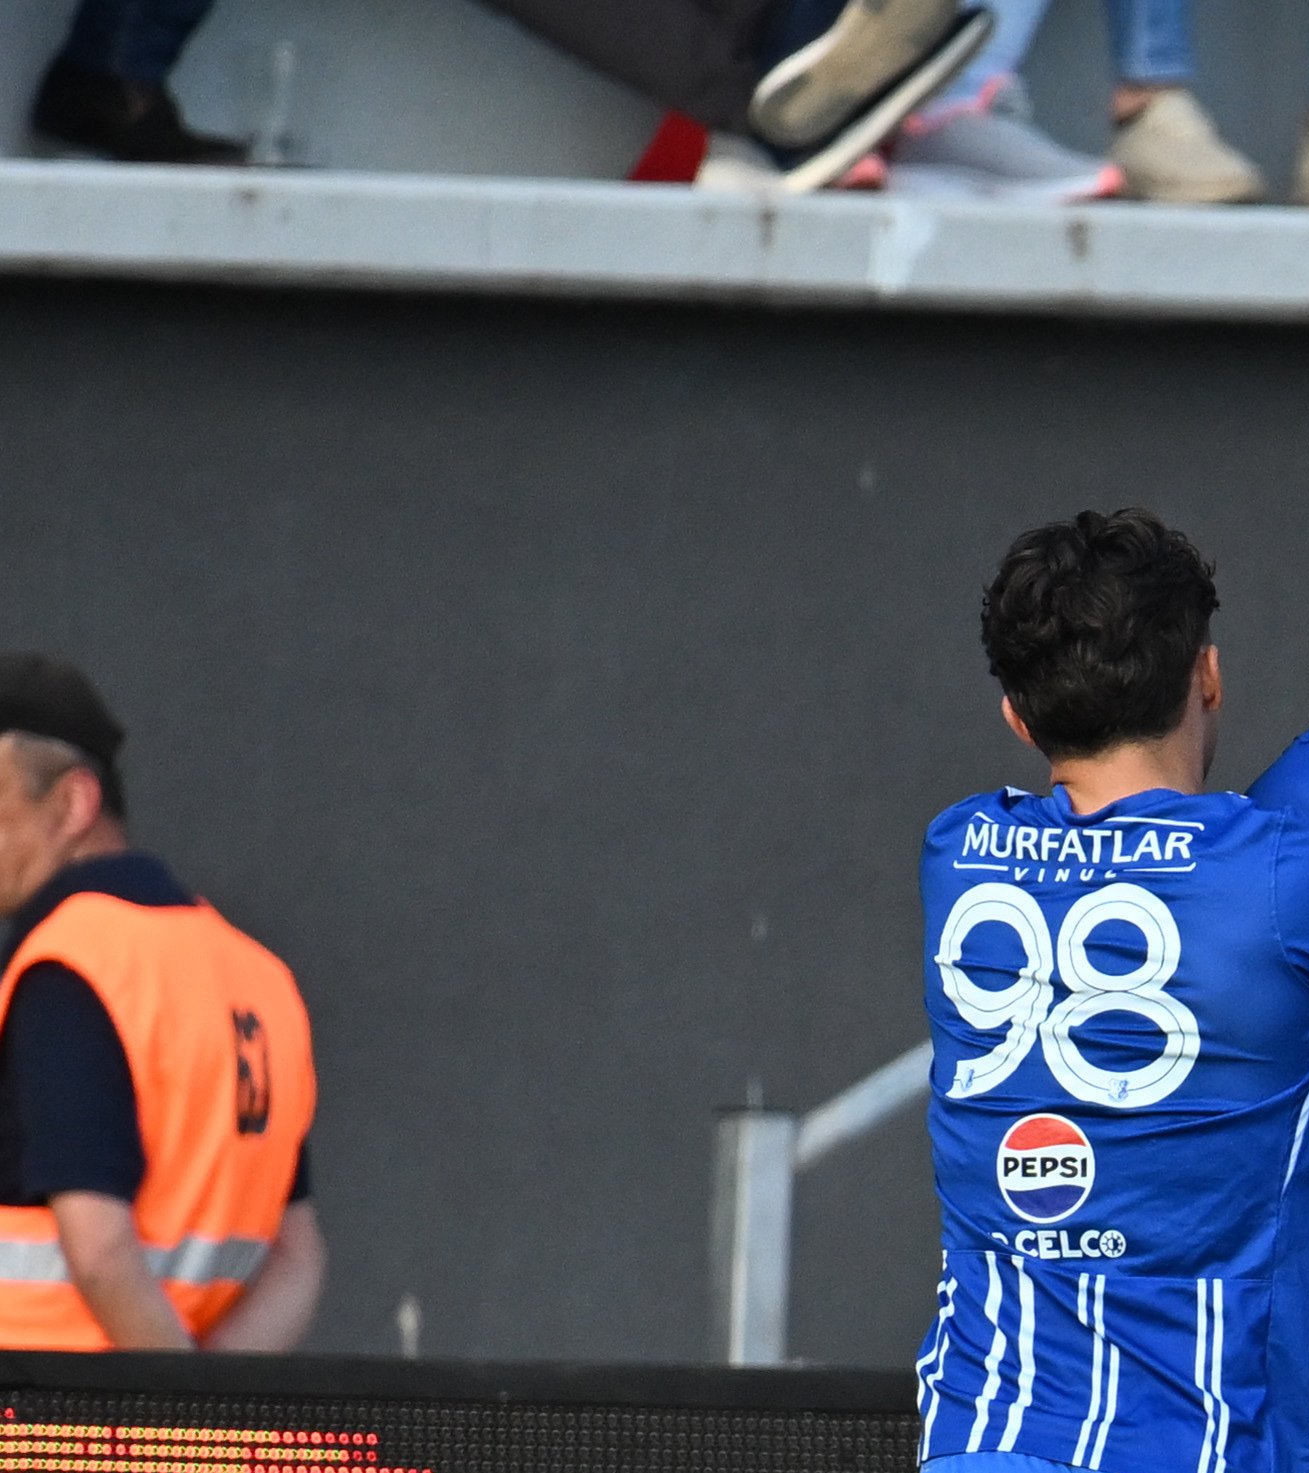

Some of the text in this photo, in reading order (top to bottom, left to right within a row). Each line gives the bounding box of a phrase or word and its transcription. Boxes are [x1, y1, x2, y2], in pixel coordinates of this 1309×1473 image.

[961, 822, 1194, 863] MURFATLAR
[1013, 867, 1117, 884] VINUL
[934, 882, 1201, 1109] 98
[1003, 1156, 1088, 1179] PEPSI
